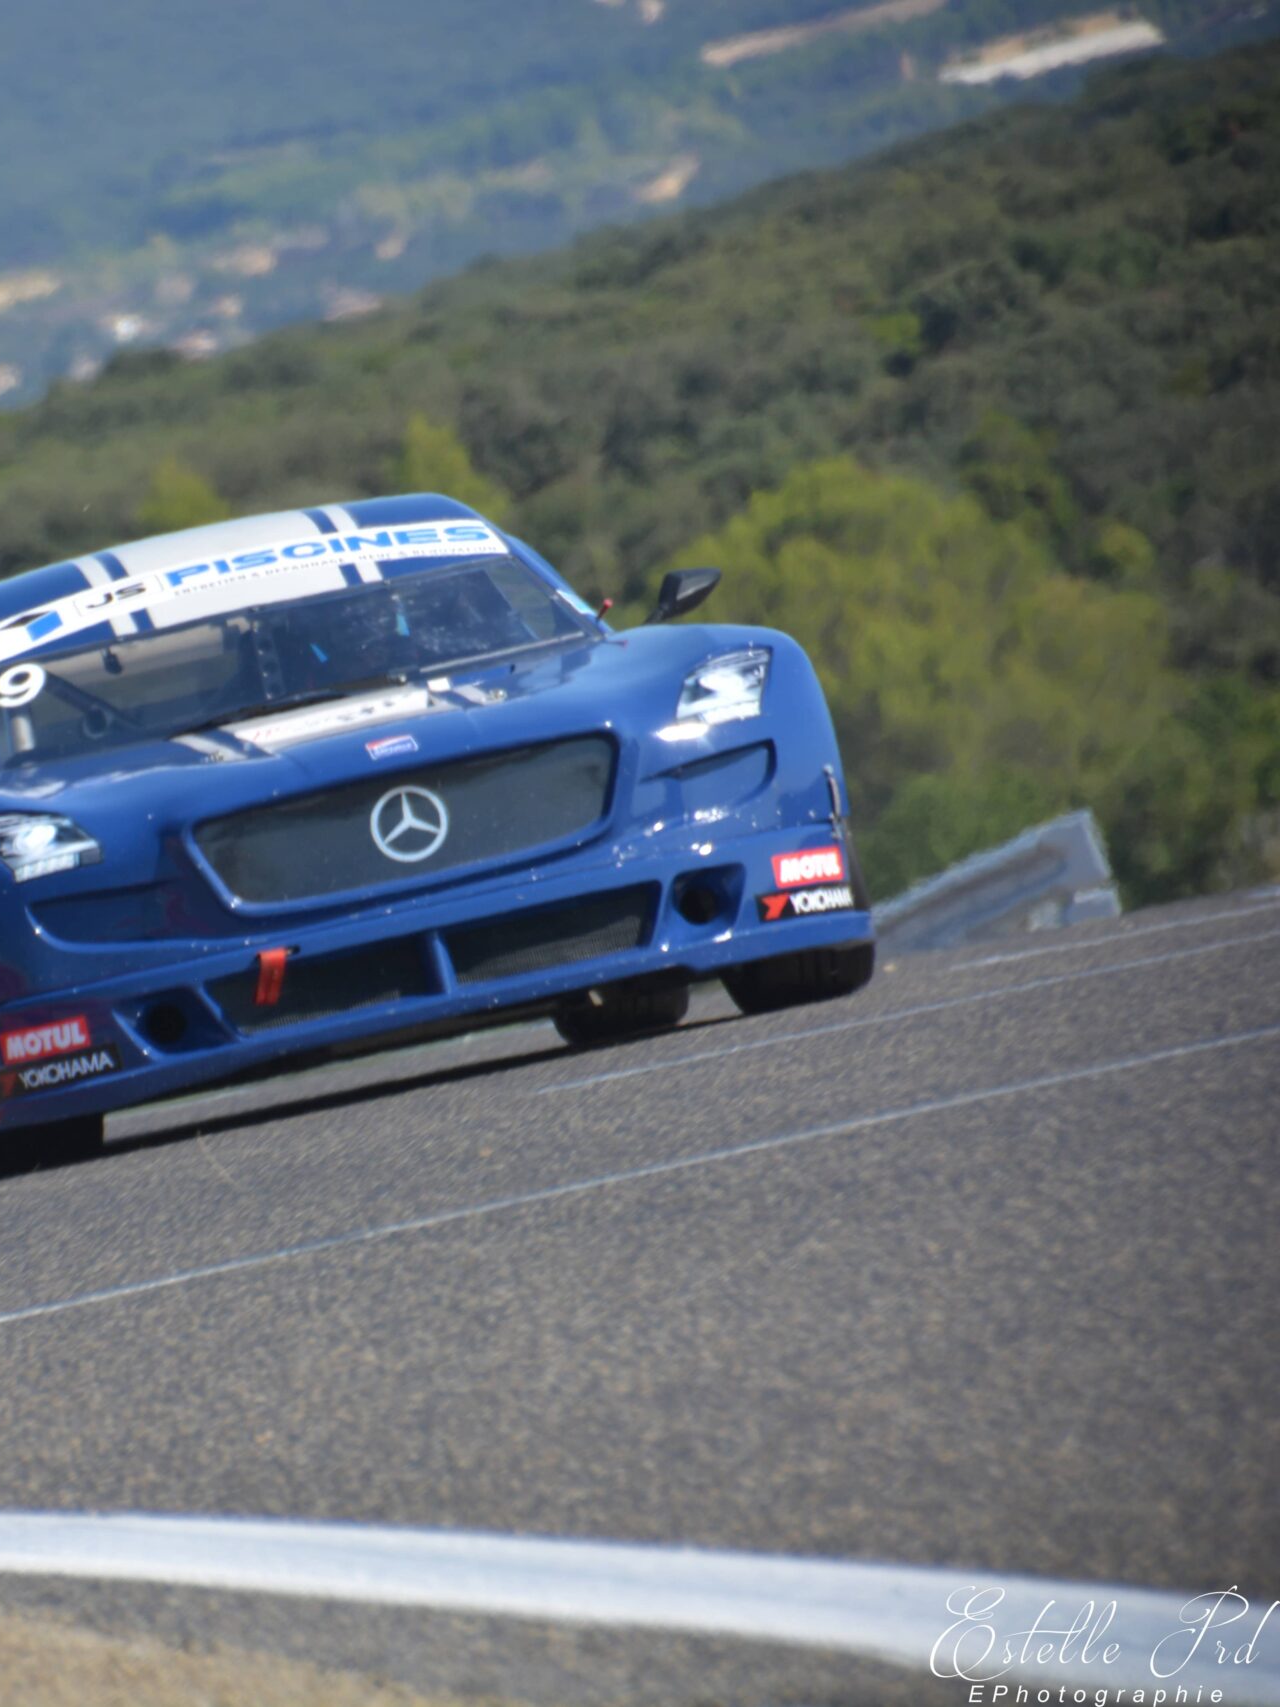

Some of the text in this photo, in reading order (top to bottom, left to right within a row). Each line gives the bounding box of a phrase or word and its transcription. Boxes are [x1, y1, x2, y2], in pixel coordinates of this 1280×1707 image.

[86, 526, 490, 610] JS PISCINES
[780, 851, 841, 884] MOTUL
[789, 885, 854, 915] YOKOHAMA
[6, 1021, 87, 1060] MOTUL
[18, 1050, 115, 1090] YOKOHAMA
